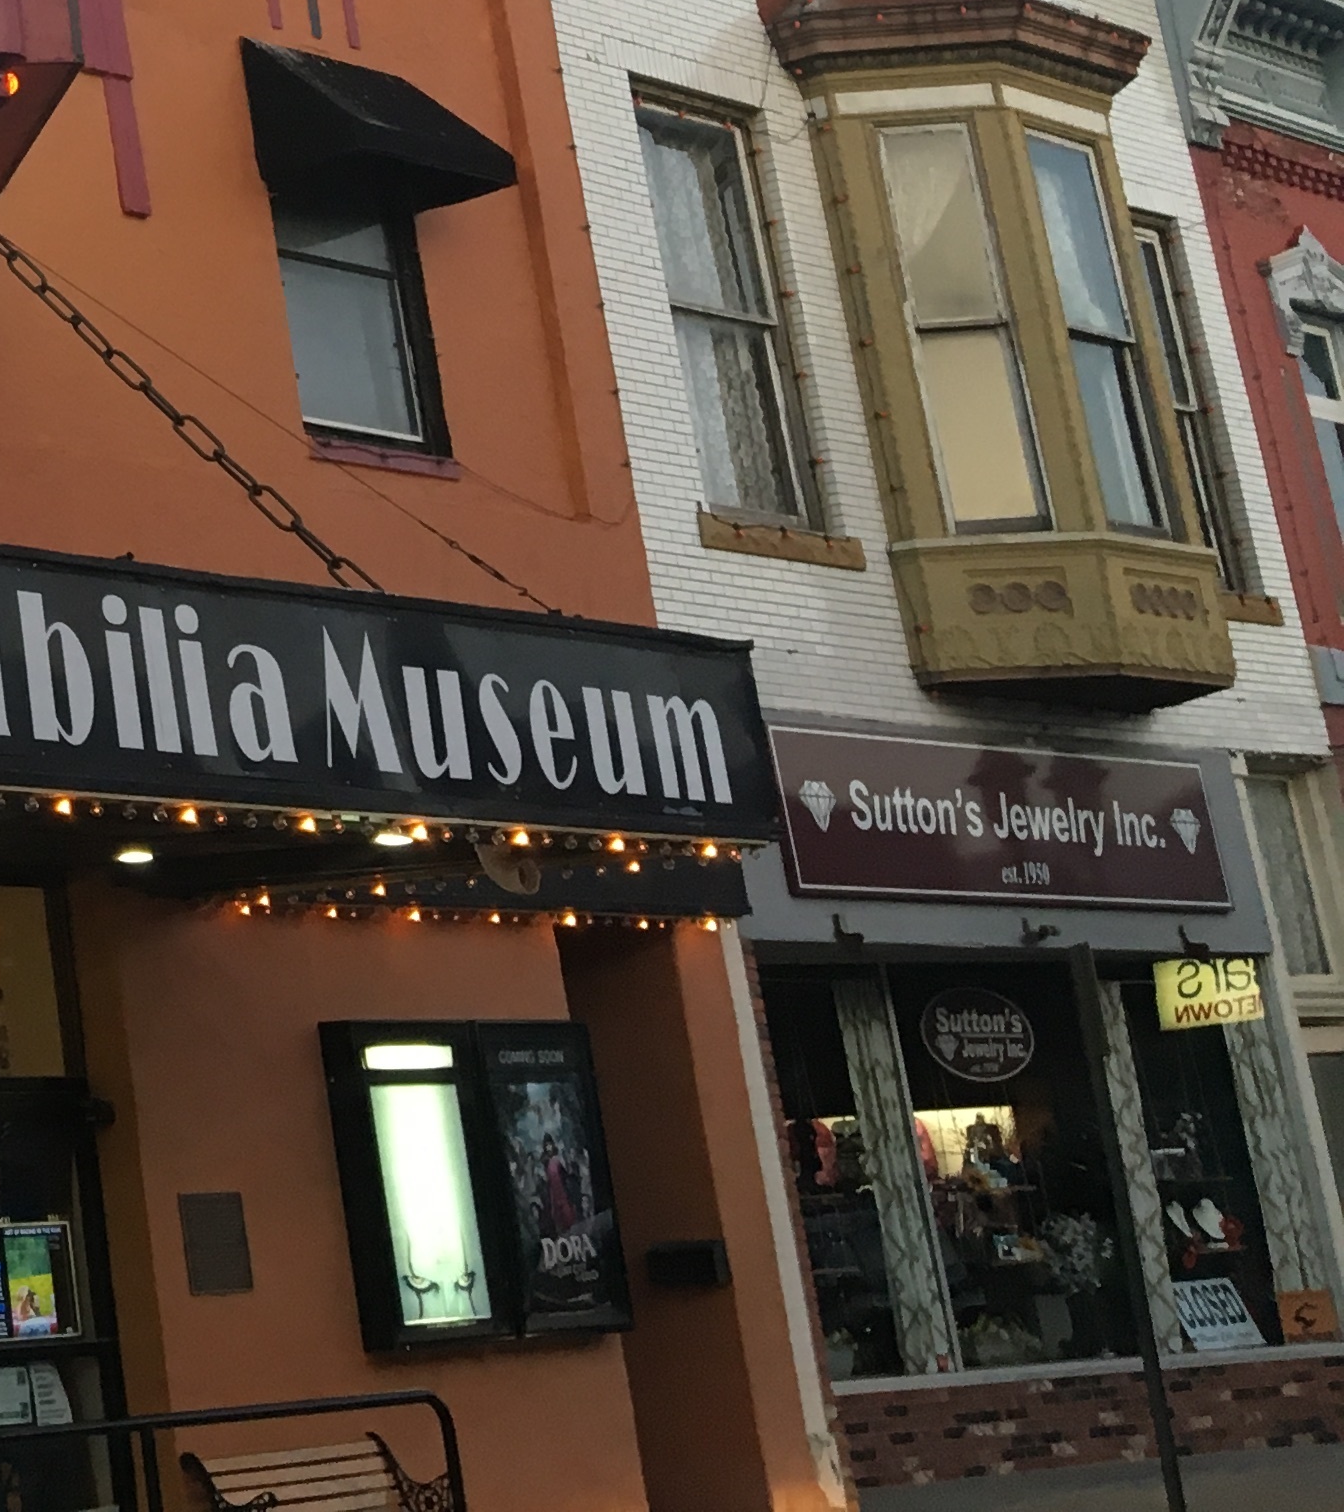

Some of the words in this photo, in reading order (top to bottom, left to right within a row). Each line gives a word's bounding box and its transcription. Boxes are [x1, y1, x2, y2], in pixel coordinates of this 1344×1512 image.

[324, 622, 734, 806] Museum
[848, 778, 984, 838] Sutton's
[993, 792, 1106, 857] Jewelry
[1113, 799, 1166, 849] Inc.
[935, 1006, 1023, 1033] Sutton's
[498, 1049, 535, 1065] COMING
[538, 1049, 565, 1065] SOON
[962, 1038, 1005, 1062] Jewelry
[540, 1233, 598, 1270] DORA
[1172, 1282, 1248, 1329] CLOSED
